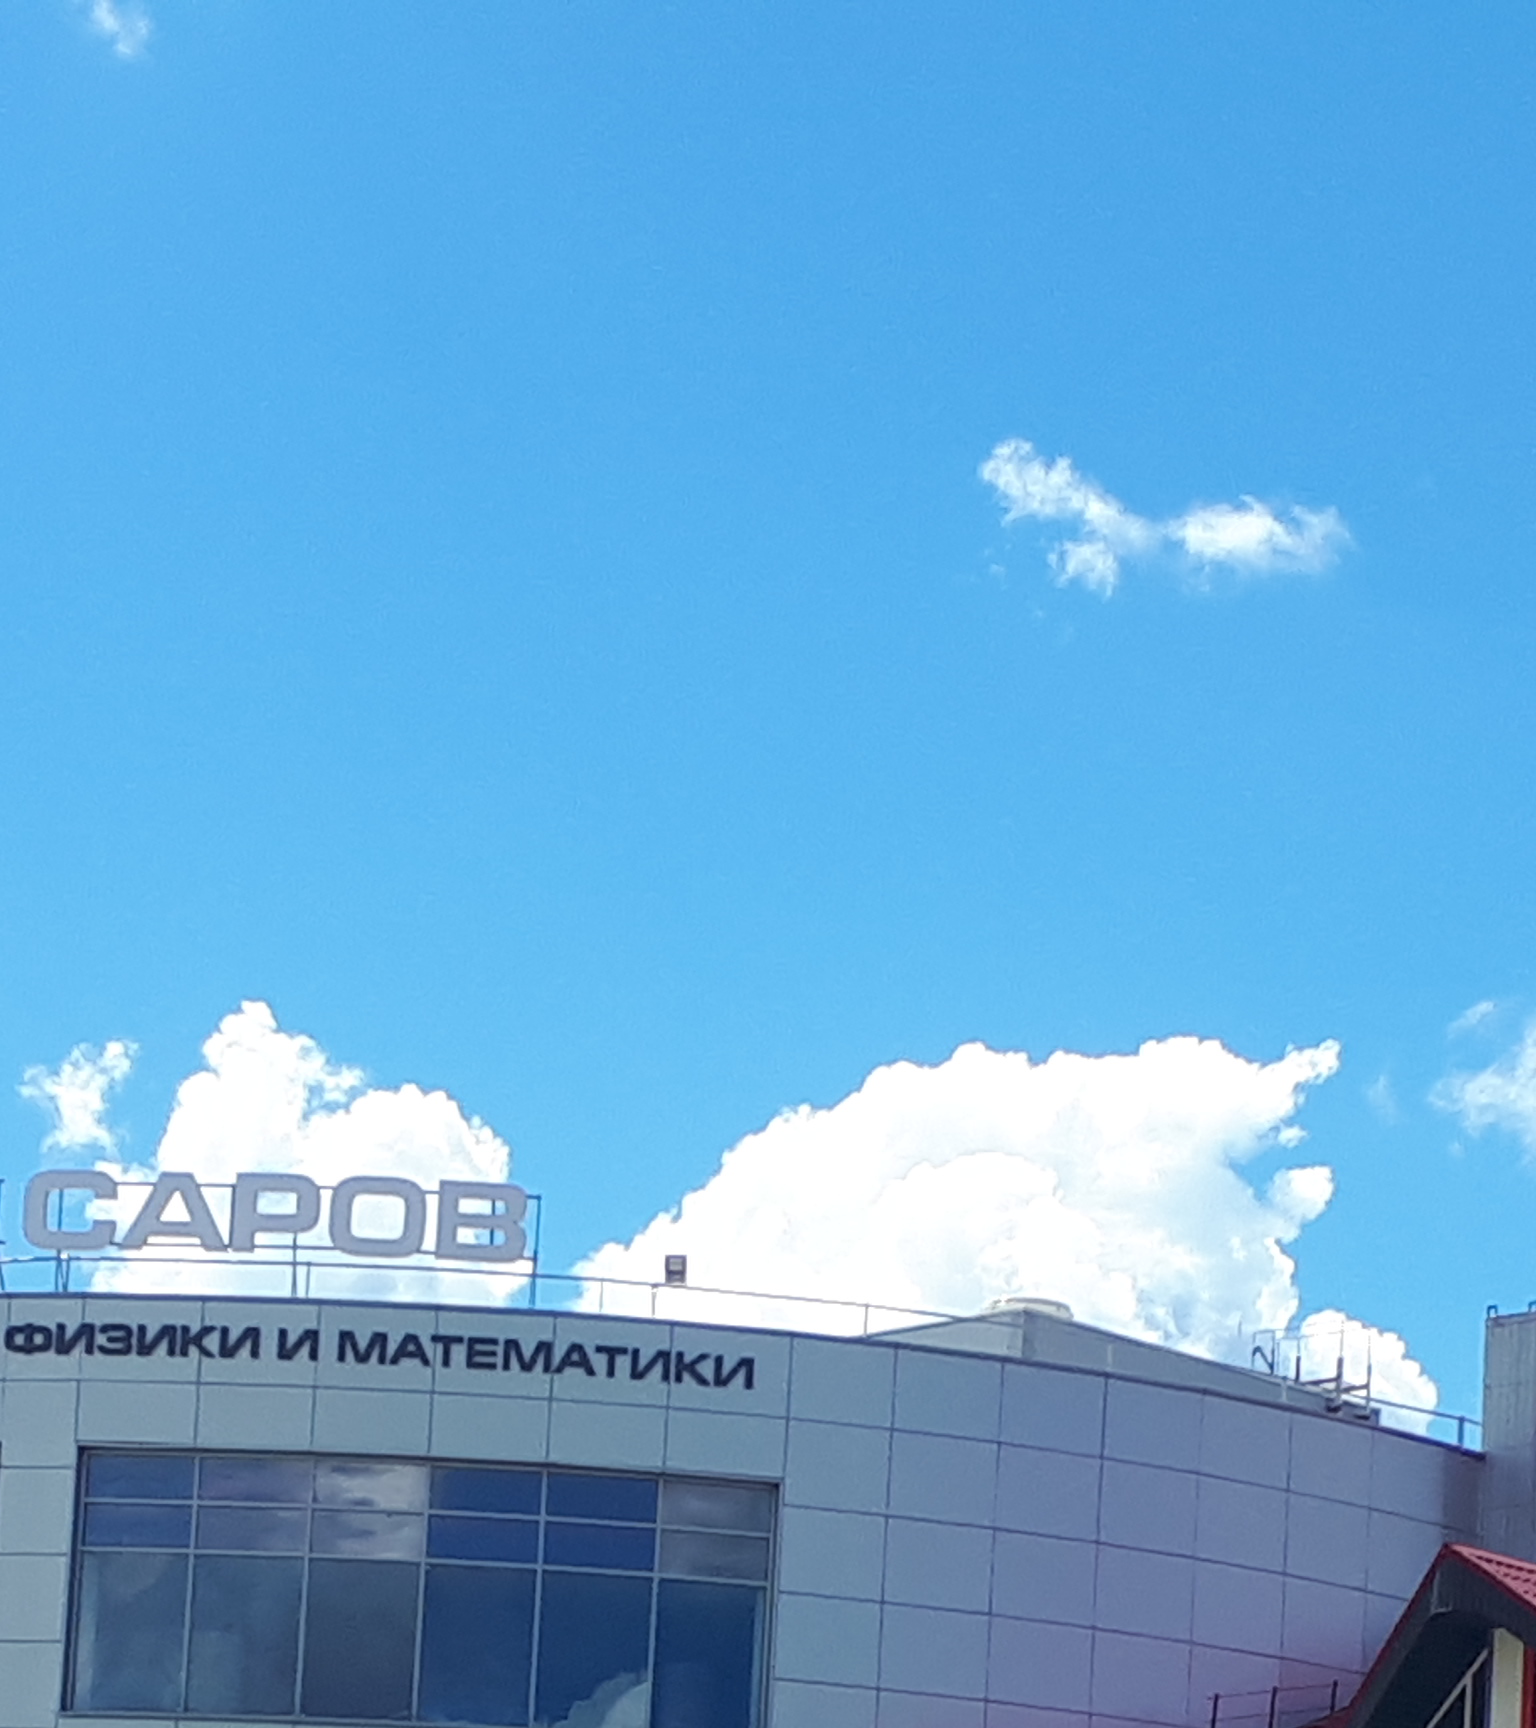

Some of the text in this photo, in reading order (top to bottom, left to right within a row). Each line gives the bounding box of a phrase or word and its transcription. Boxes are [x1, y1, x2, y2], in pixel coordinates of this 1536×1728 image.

[23, 1169, 529, 1262] САРОВ
[4, 1322, 261, 1360] ФИЗИКИ
[276, 1327, 319, 1361] И
[336, 1328, 756, 1391] МАТЕМАТИКИ
